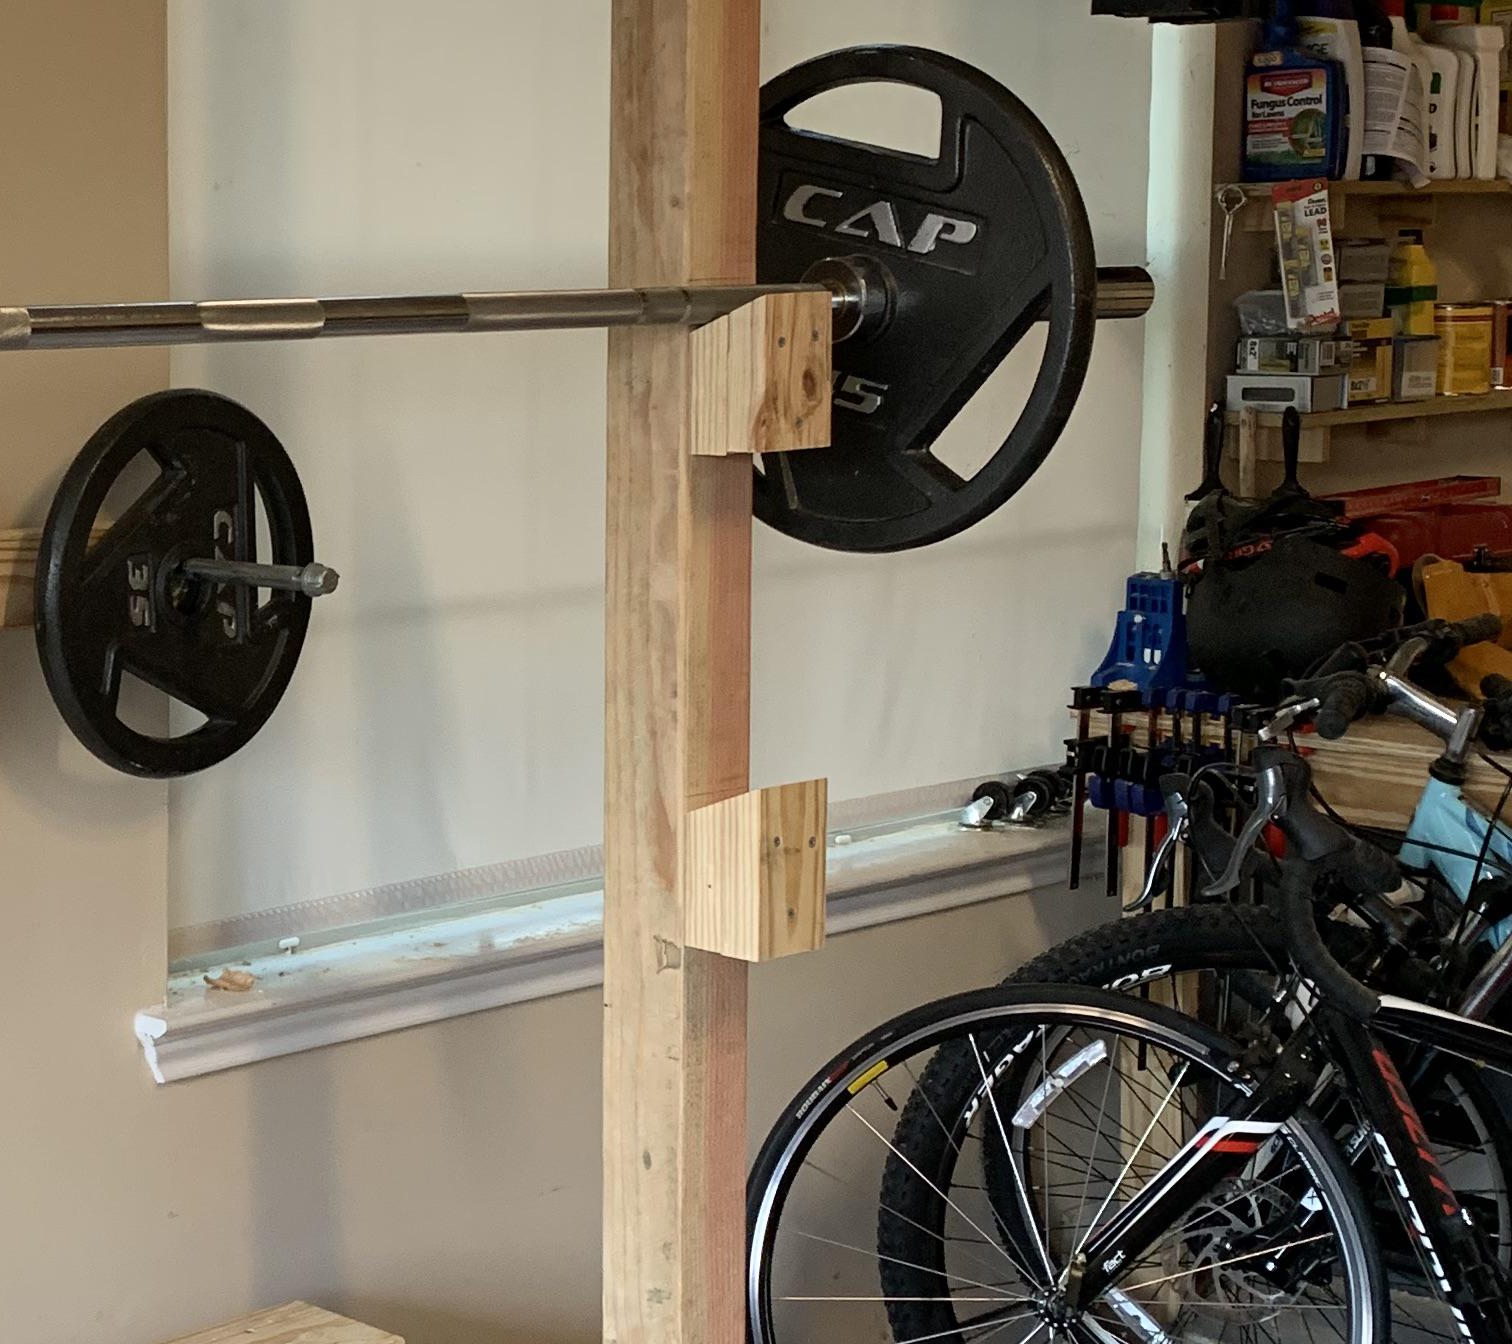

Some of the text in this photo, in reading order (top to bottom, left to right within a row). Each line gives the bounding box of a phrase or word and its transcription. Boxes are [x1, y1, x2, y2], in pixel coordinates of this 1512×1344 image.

[1251, 95, 1323, 111] Fungus Control
[782, 183, 979, 255] CAP
[1304, 206, 1328, 218] LEAD
[831, 372, 888, 416] 5
[127, 560, 151, 629] 35
